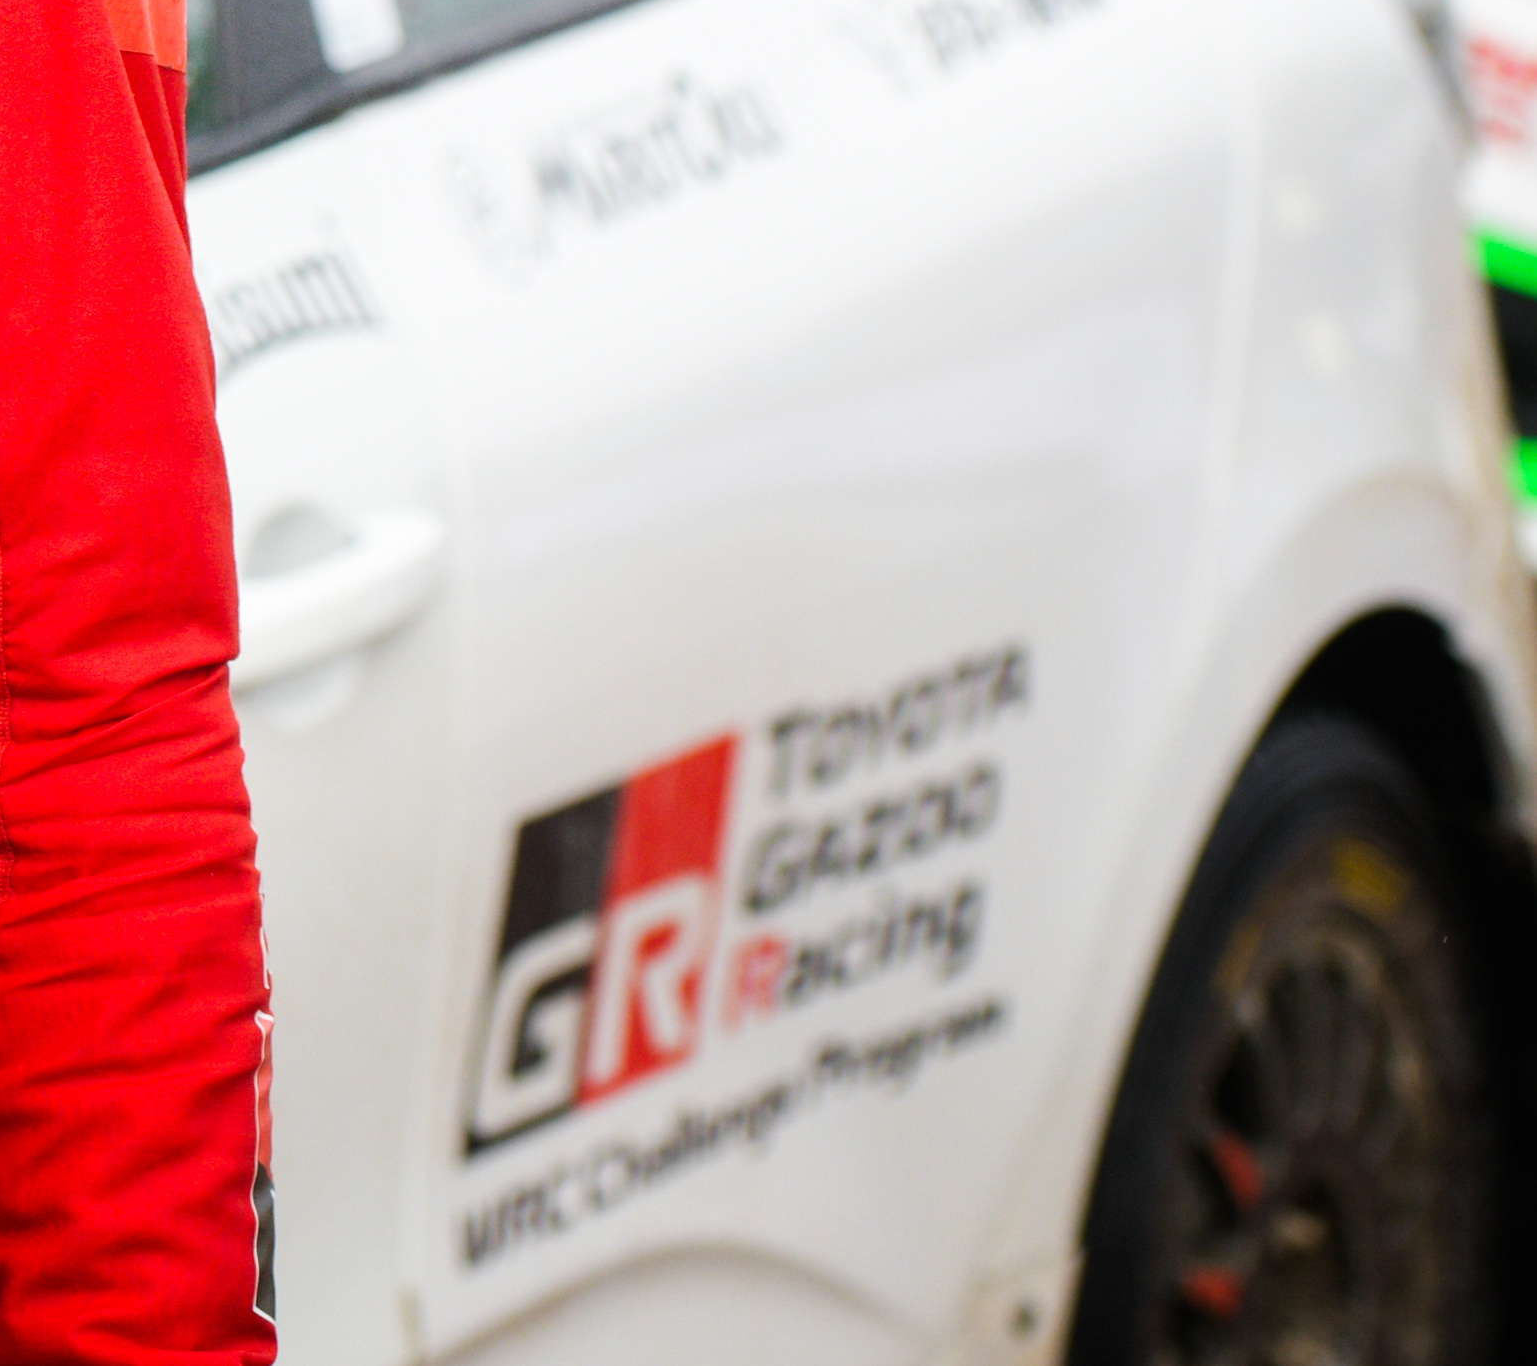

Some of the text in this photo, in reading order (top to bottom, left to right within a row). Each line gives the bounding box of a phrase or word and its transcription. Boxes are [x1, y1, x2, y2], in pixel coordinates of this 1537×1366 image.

[766, 642, 1033, 800] TOYOTA
[742, 764, 1001, 914] GAZOO
[470, 872, 718, 1140] GR
[720, 878, 984, 1038] Racing
